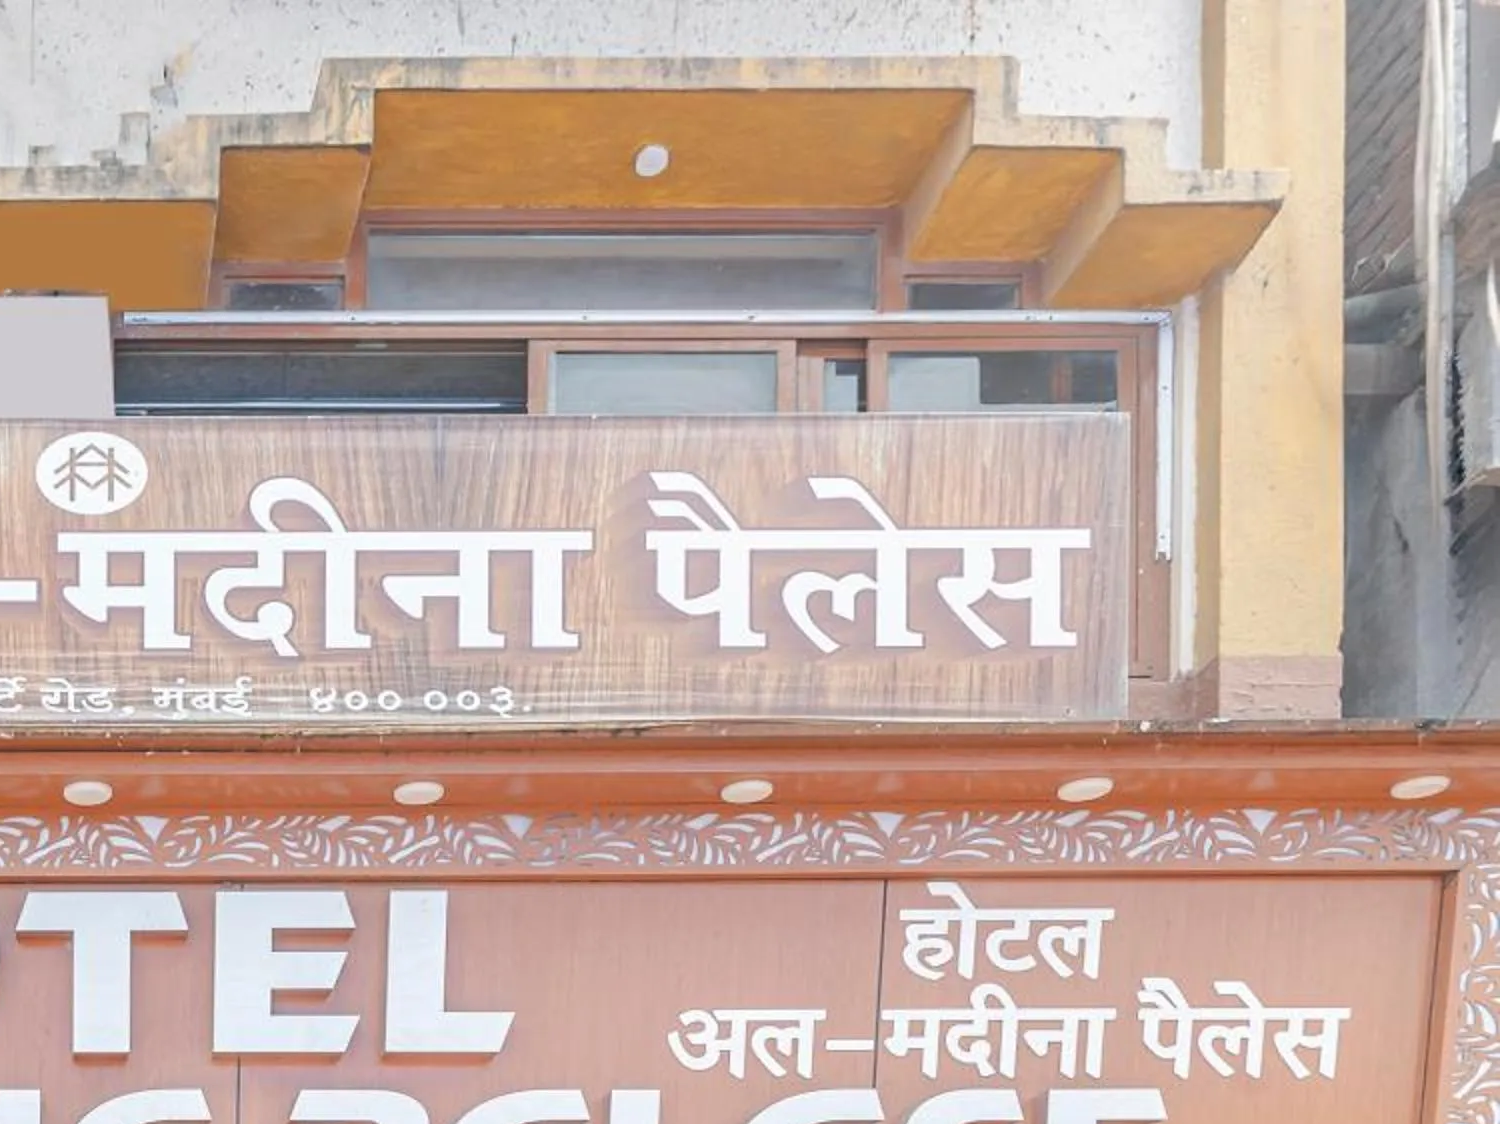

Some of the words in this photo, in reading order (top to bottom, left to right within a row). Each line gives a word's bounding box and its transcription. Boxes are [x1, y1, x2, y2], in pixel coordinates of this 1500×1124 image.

[647, 472, 1091, 653] पैलेस
[151, 676, 252, 719] मुंबई
[309, 687, 401, 712] ४००
[900, 882, 1115, 980] होटल
[667, 983, 1116, 1079] अल-मदीना
[1137, 977, 1351, 1080] पैलेस
